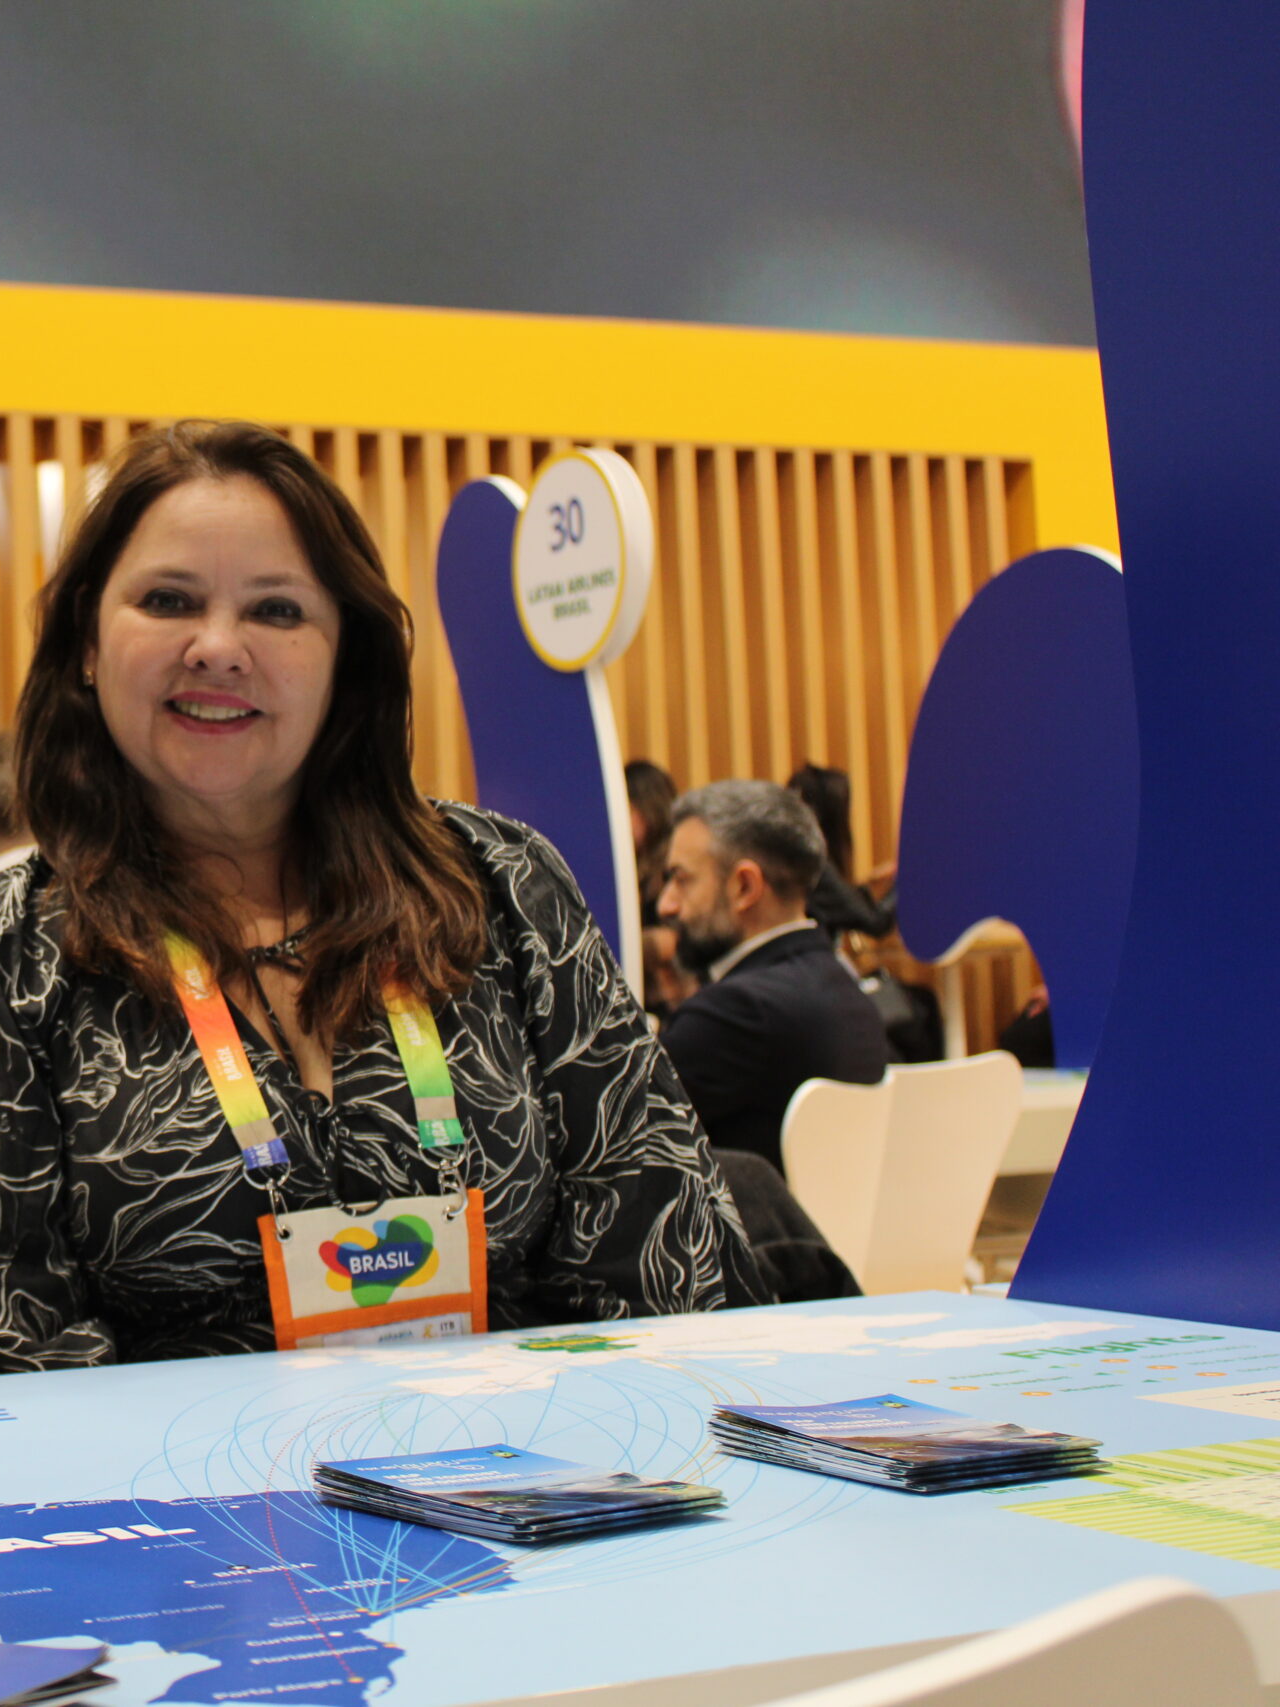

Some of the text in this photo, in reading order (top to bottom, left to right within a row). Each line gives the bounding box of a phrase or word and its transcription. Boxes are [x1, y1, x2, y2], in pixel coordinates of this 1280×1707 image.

[549, 497, 584, 553] 30
[349, 1251, 415, 1274] BRASIL
[999, 1334, 1226, 1360] Flights
